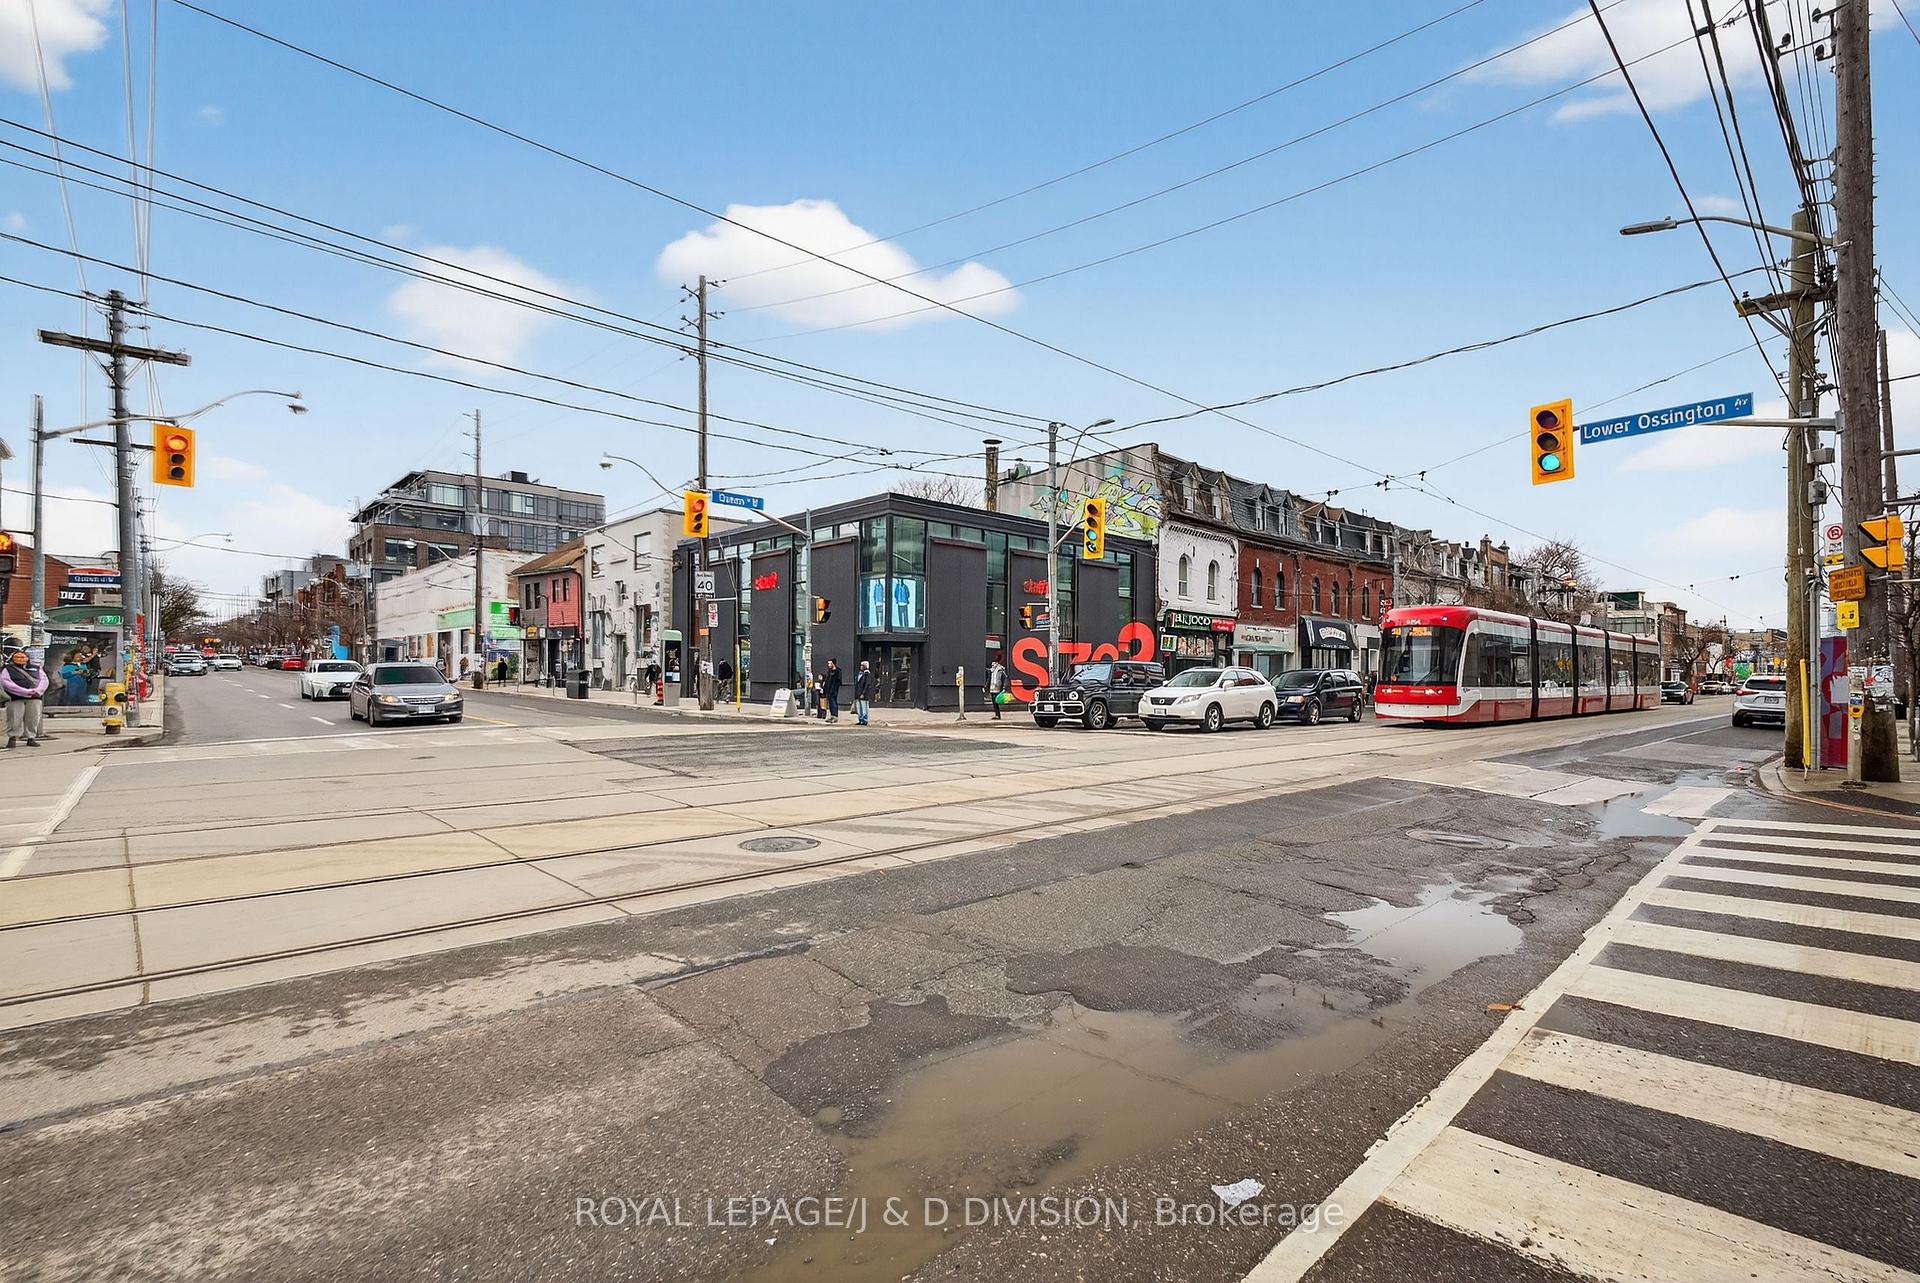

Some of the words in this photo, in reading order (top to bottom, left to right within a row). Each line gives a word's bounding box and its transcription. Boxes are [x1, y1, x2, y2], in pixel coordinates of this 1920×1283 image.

[1583, 420, 1631, 439] Lower
[1637, 403, 1726, 429] Ossington
[697, 580, 713, 591] 40
